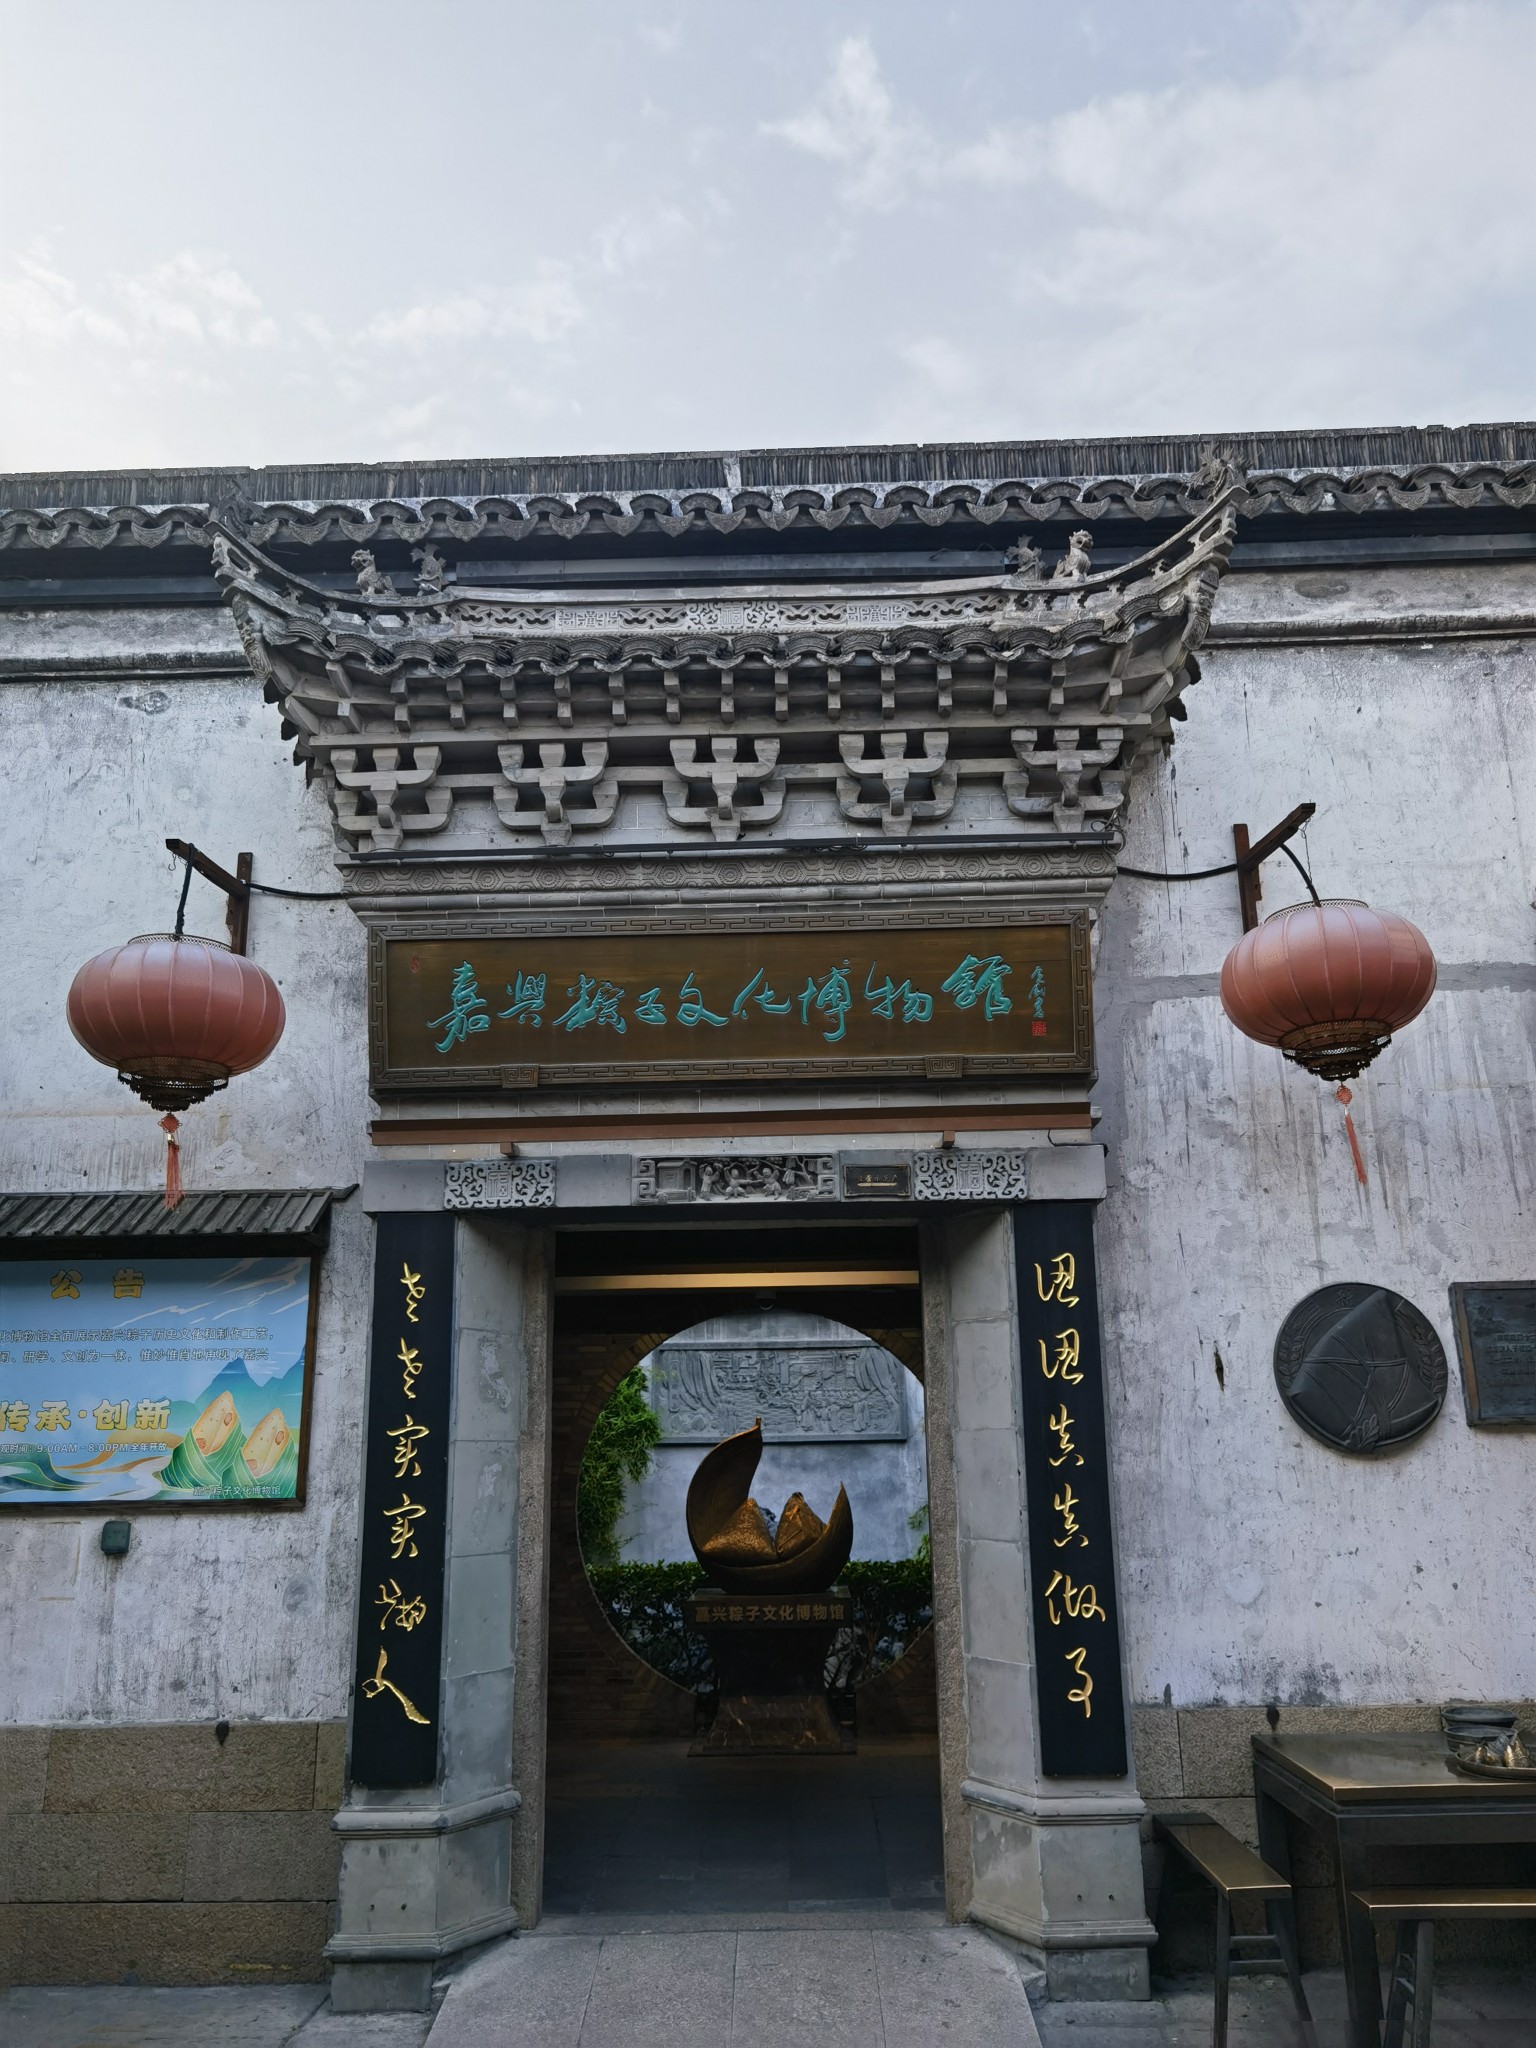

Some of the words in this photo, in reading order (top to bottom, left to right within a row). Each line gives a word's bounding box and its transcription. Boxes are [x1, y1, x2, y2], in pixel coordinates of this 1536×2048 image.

[51, 1268, 145, 1299] 公告
[695, 1604, 844, 1623] 嘉兴粽子文化博物馆
